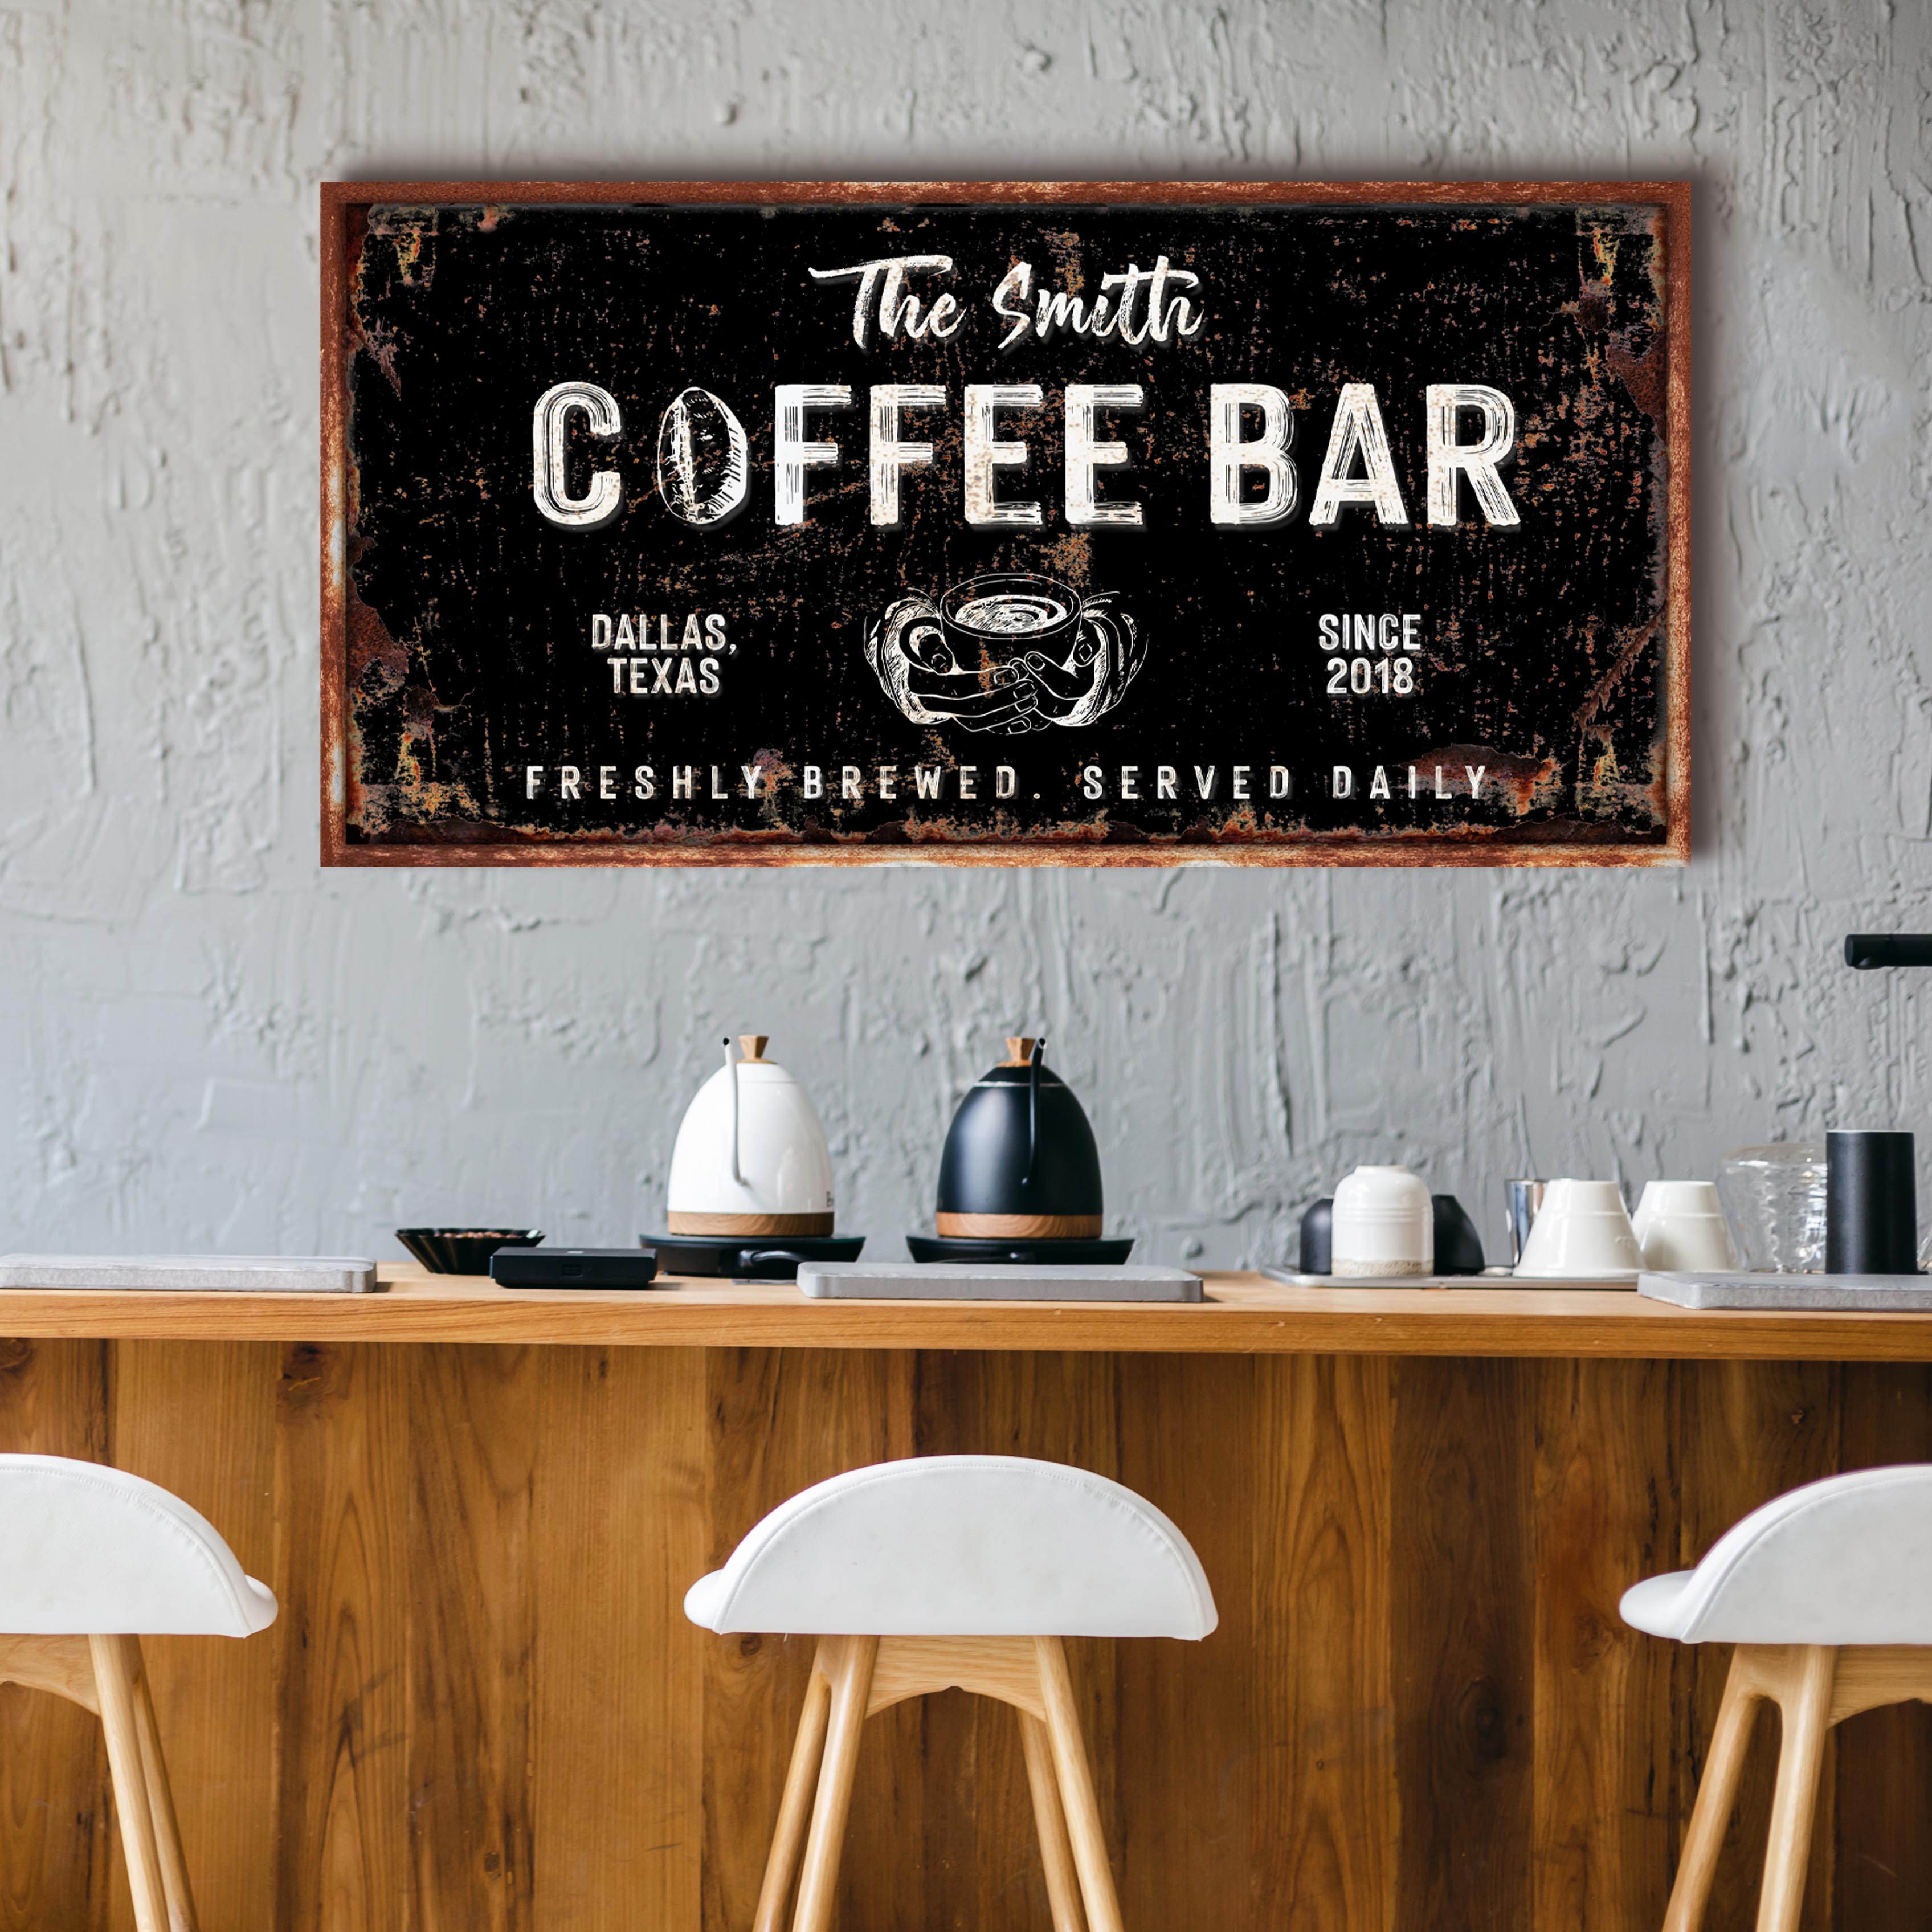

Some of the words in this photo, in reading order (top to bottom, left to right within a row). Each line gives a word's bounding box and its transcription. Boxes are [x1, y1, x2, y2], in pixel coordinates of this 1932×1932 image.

[807, 254, 967, 348] The
[992, 255, 1203, 349] Smith
[533, 381, 1144, 526] COFFEE
[1210, 383, 1521, 526] BAR
[591, 614, 737, 655] DALLAS,
[1318, 613, 1421, 650] SINCE
[607, 657, 720, 694] TEXAS
[1326, 657, 1414, 694] 2018
[526, 765, 762, 799] FRESHLY
[803, 765, 1041, 799] BREWED.
[1083, 765, 1289, 800] SERVED
[1333, 765, 1486, 799] DAILY
